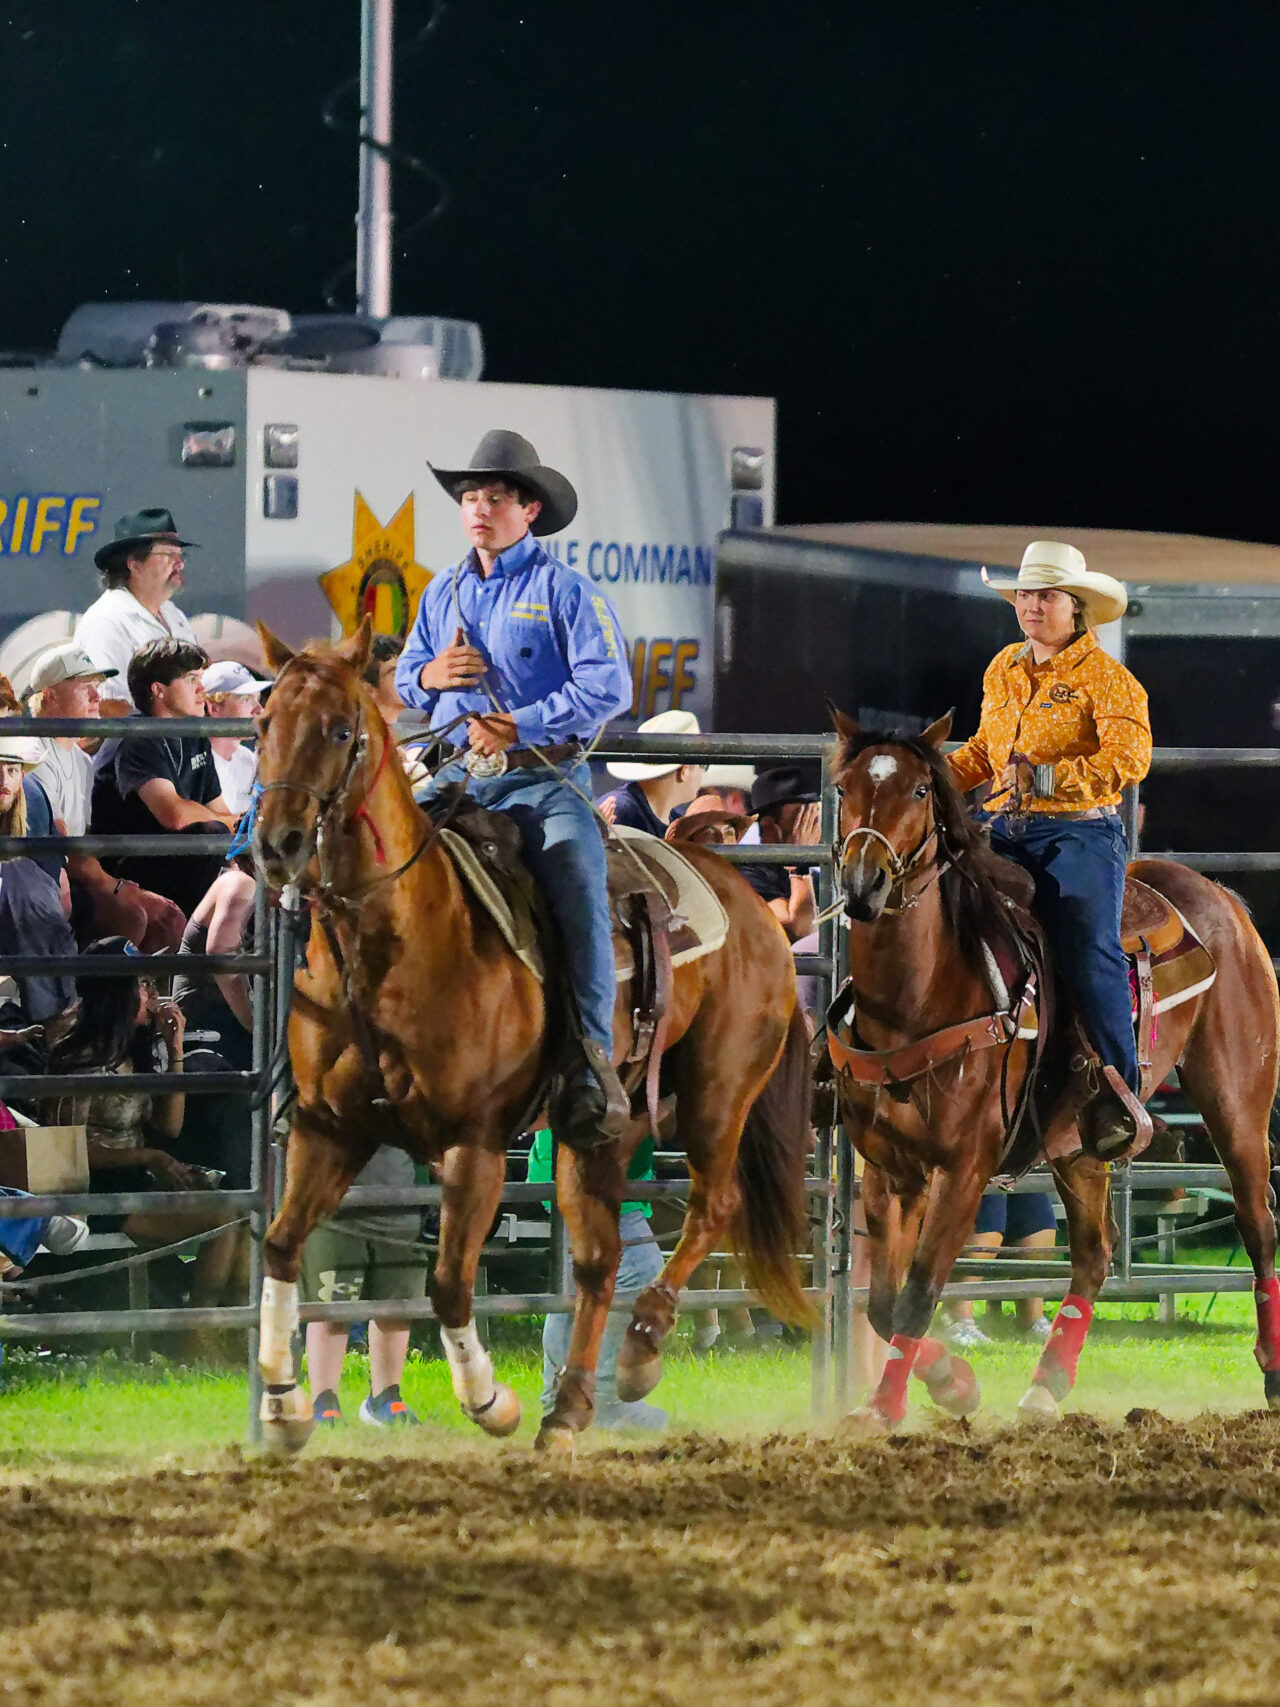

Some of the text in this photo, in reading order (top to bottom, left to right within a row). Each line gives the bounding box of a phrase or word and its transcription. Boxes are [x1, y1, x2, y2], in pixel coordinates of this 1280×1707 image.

[0, 495, 101, 556] IFF
[587, 540, 713, 587] COMMAN
[627, 637, 699, 719] IFF
